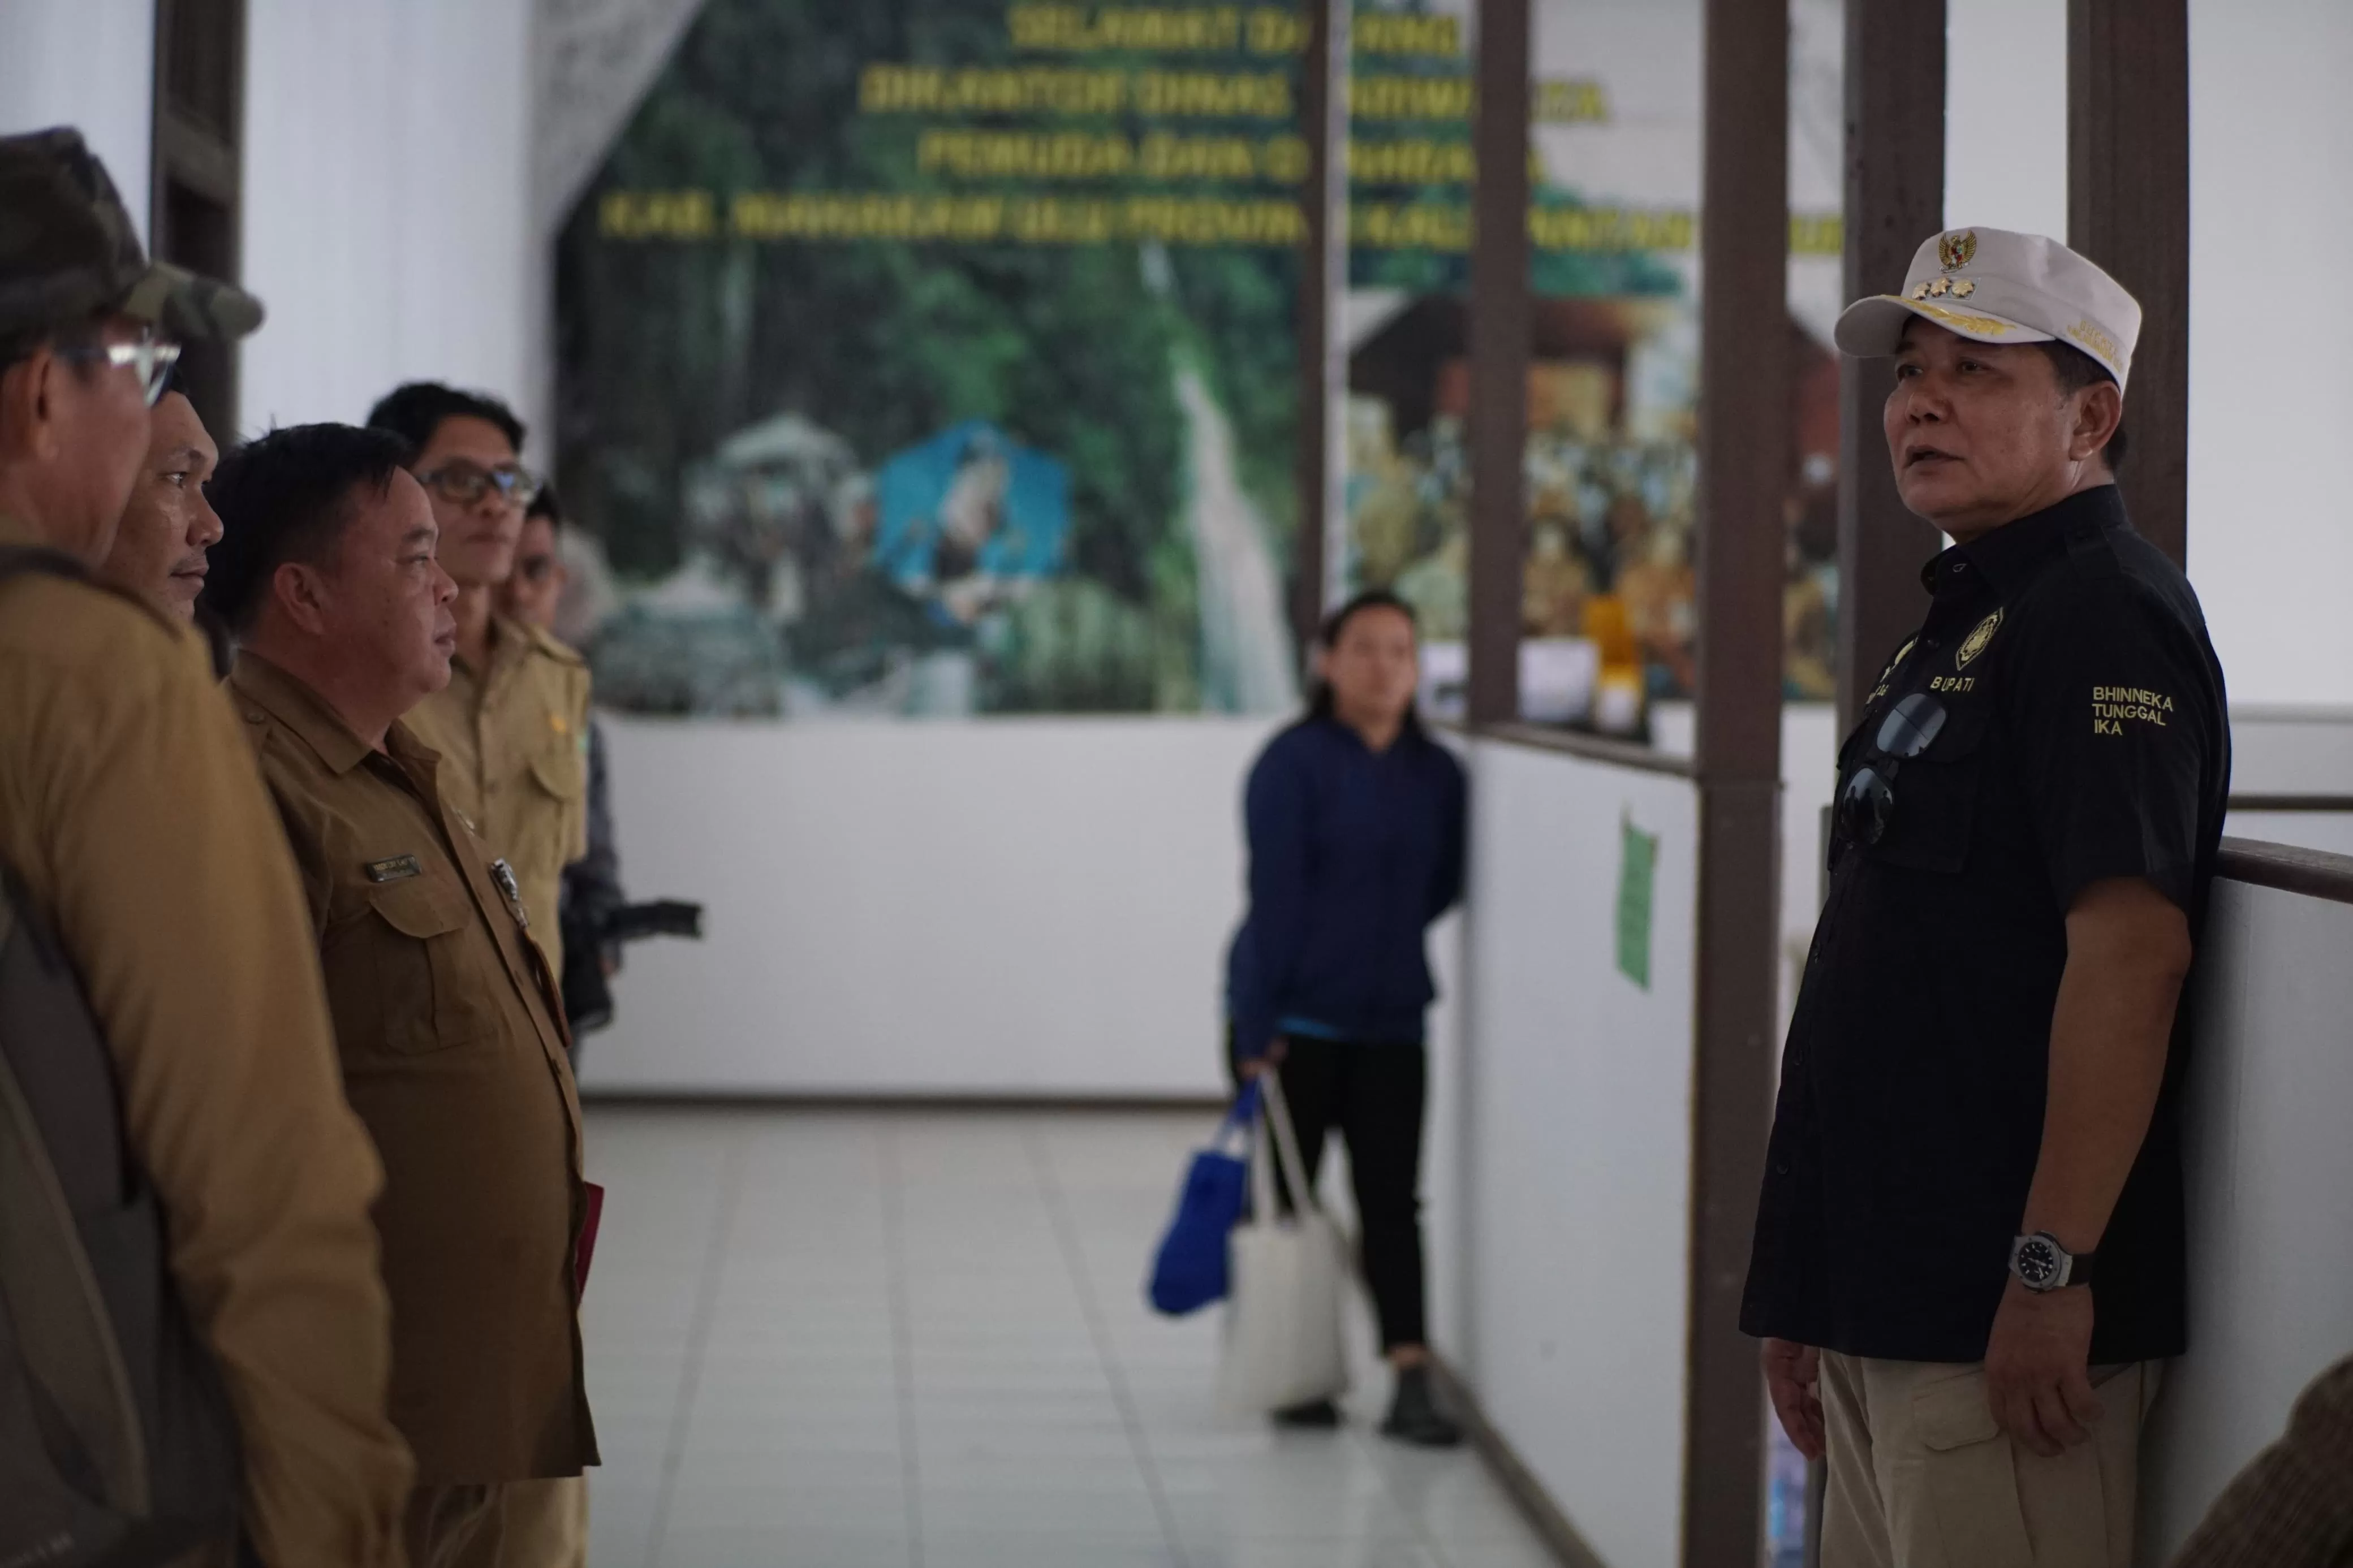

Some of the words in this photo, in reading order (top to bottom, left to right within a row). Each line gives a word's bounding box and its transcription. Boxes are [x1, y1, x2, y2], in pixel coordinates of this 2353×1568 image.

[1930, 676, 1975, 692] BUPATI
[2093, 686, 2173, 712] BHINNEKA
[2092, 703, 2166, 726] TUNGGAL
[2094, 719, 2122, 735] IKA
